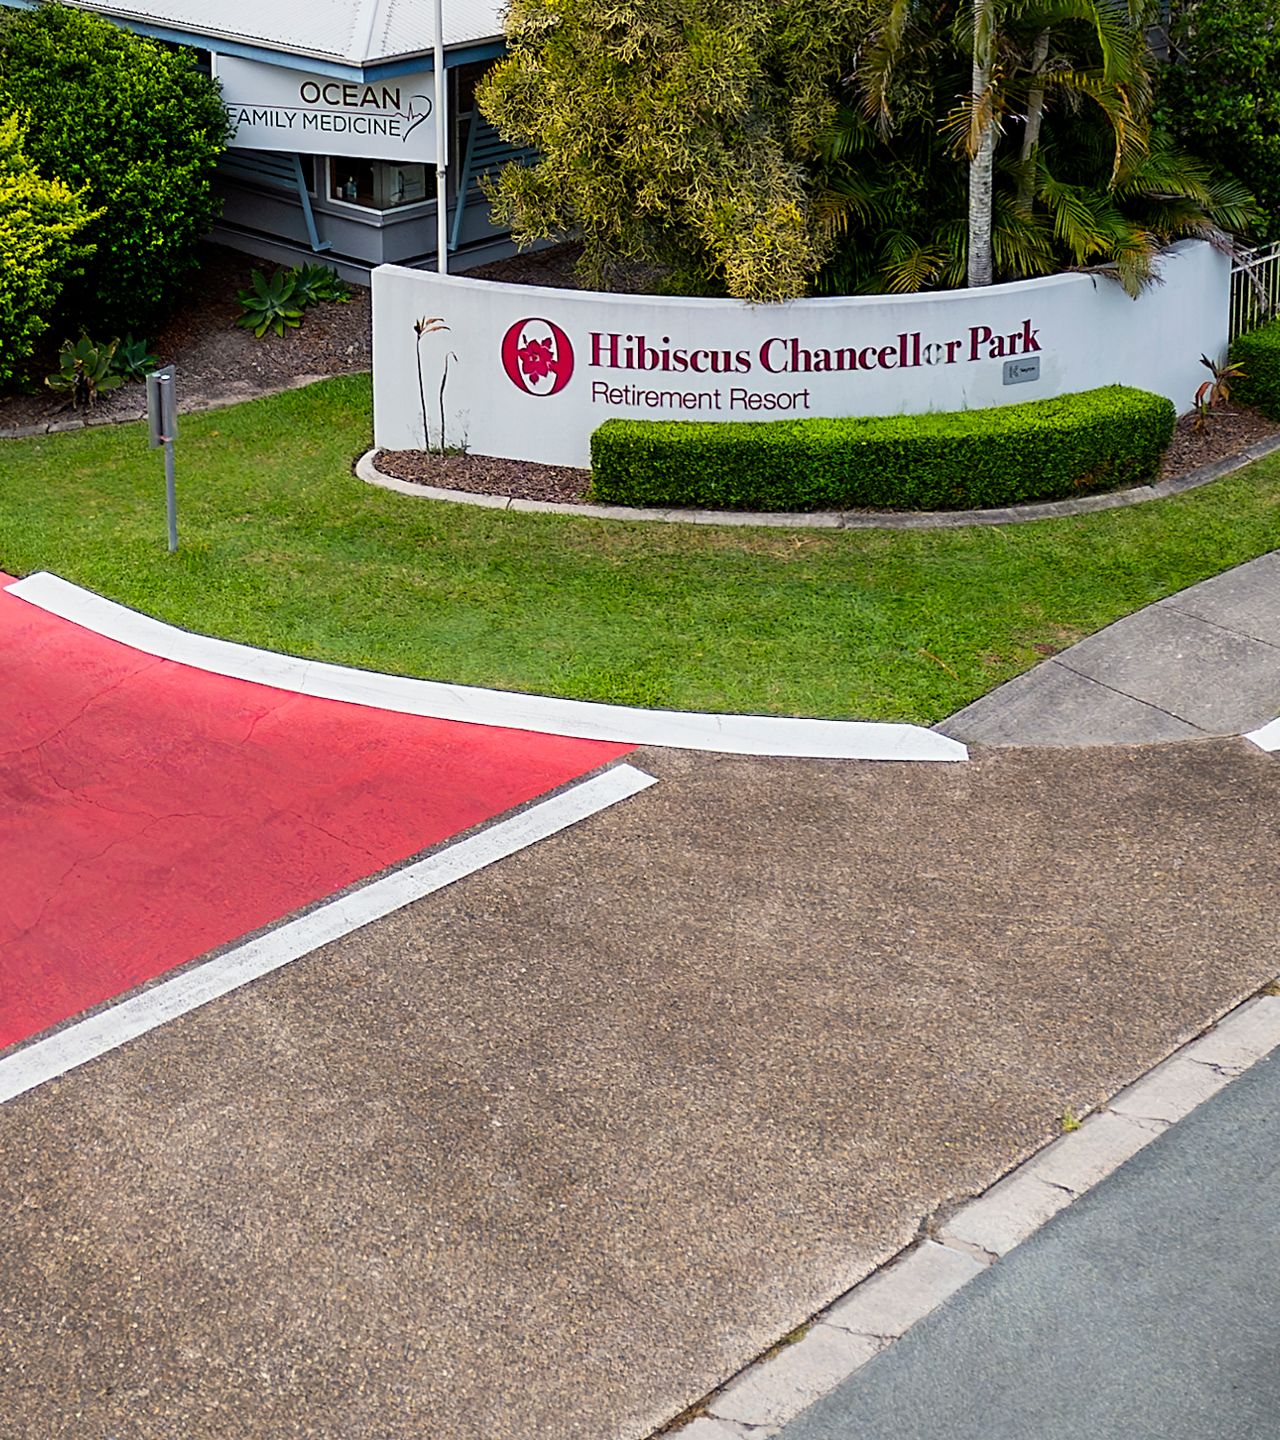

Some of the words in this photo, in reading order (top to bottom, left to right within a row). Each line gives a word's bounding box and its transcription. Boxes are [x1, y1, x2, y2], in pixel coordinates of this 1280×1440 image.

[300, 81, 401, 110] OCEAN
[227, 108, 297, 128] FAMILY
[303, 114, 401, 137] MEDICINE
[588, 332, 751, 374] Hibiscus
[760, 331, 963, 374] Chancellor
[967, 318, 1043, 362] Park
[592, 381, 722, 410] Retirement
[730, 388, 811, 411] Resort
